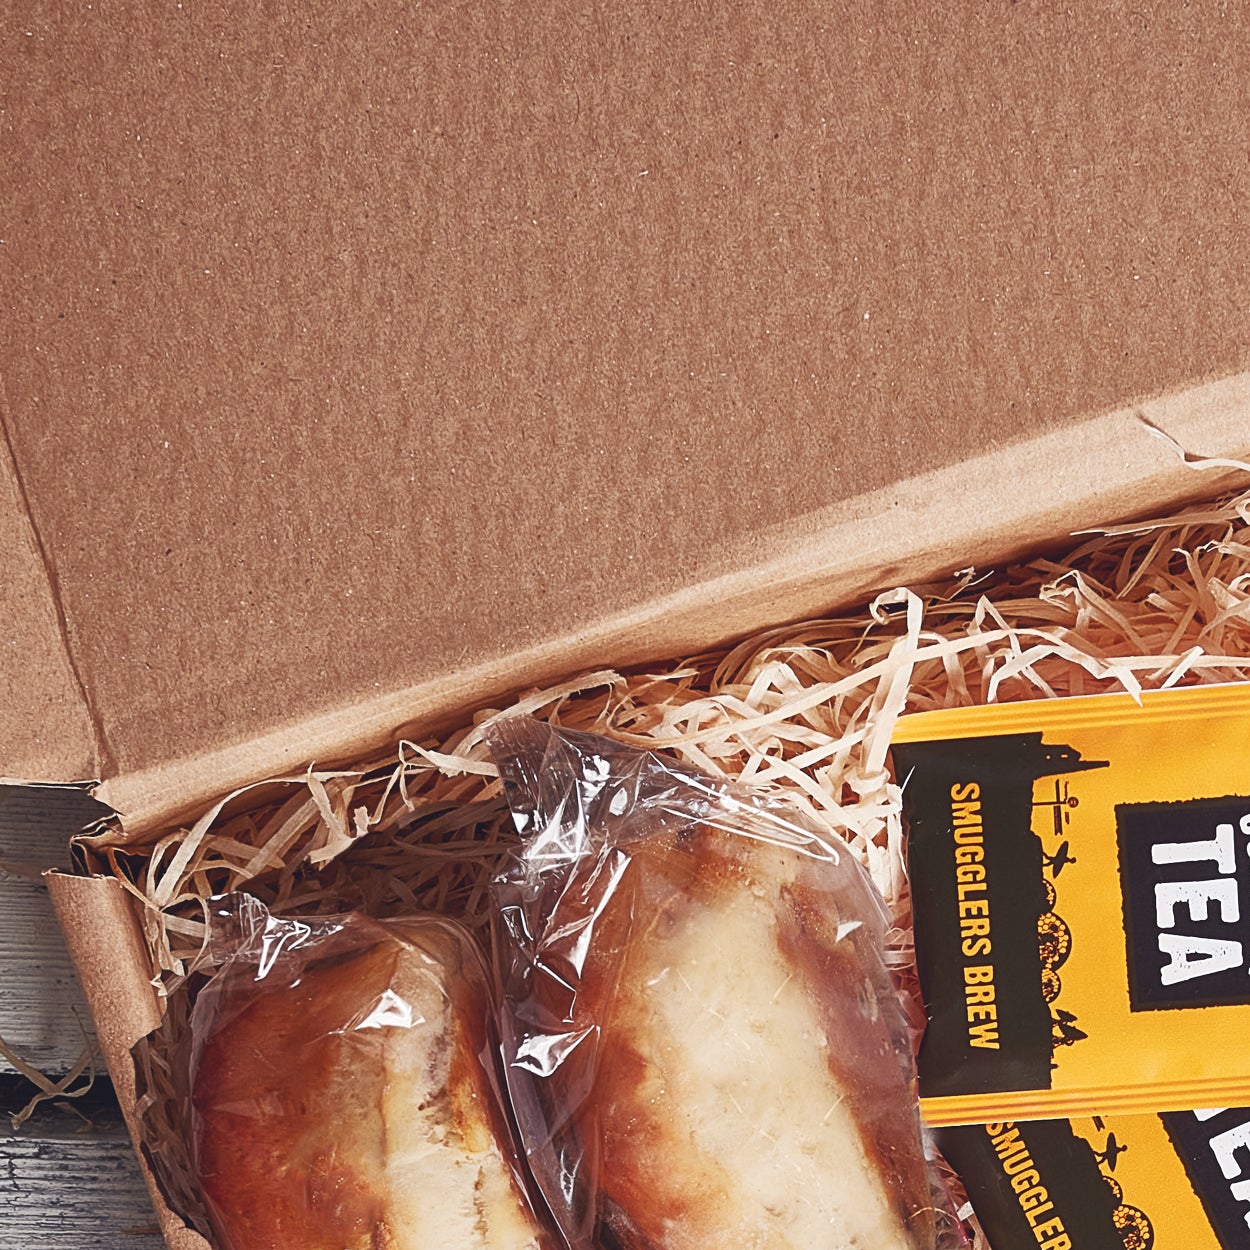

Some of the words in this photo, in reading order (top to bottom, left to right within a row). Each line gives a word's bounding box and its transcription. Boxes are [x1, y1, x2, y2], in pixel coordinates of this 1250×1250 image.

[950, 782, 992, 957] SMUGGLERS
[1151, 824, 1243, 986] TEA
[963, 965, 1000, 1050] BREW
